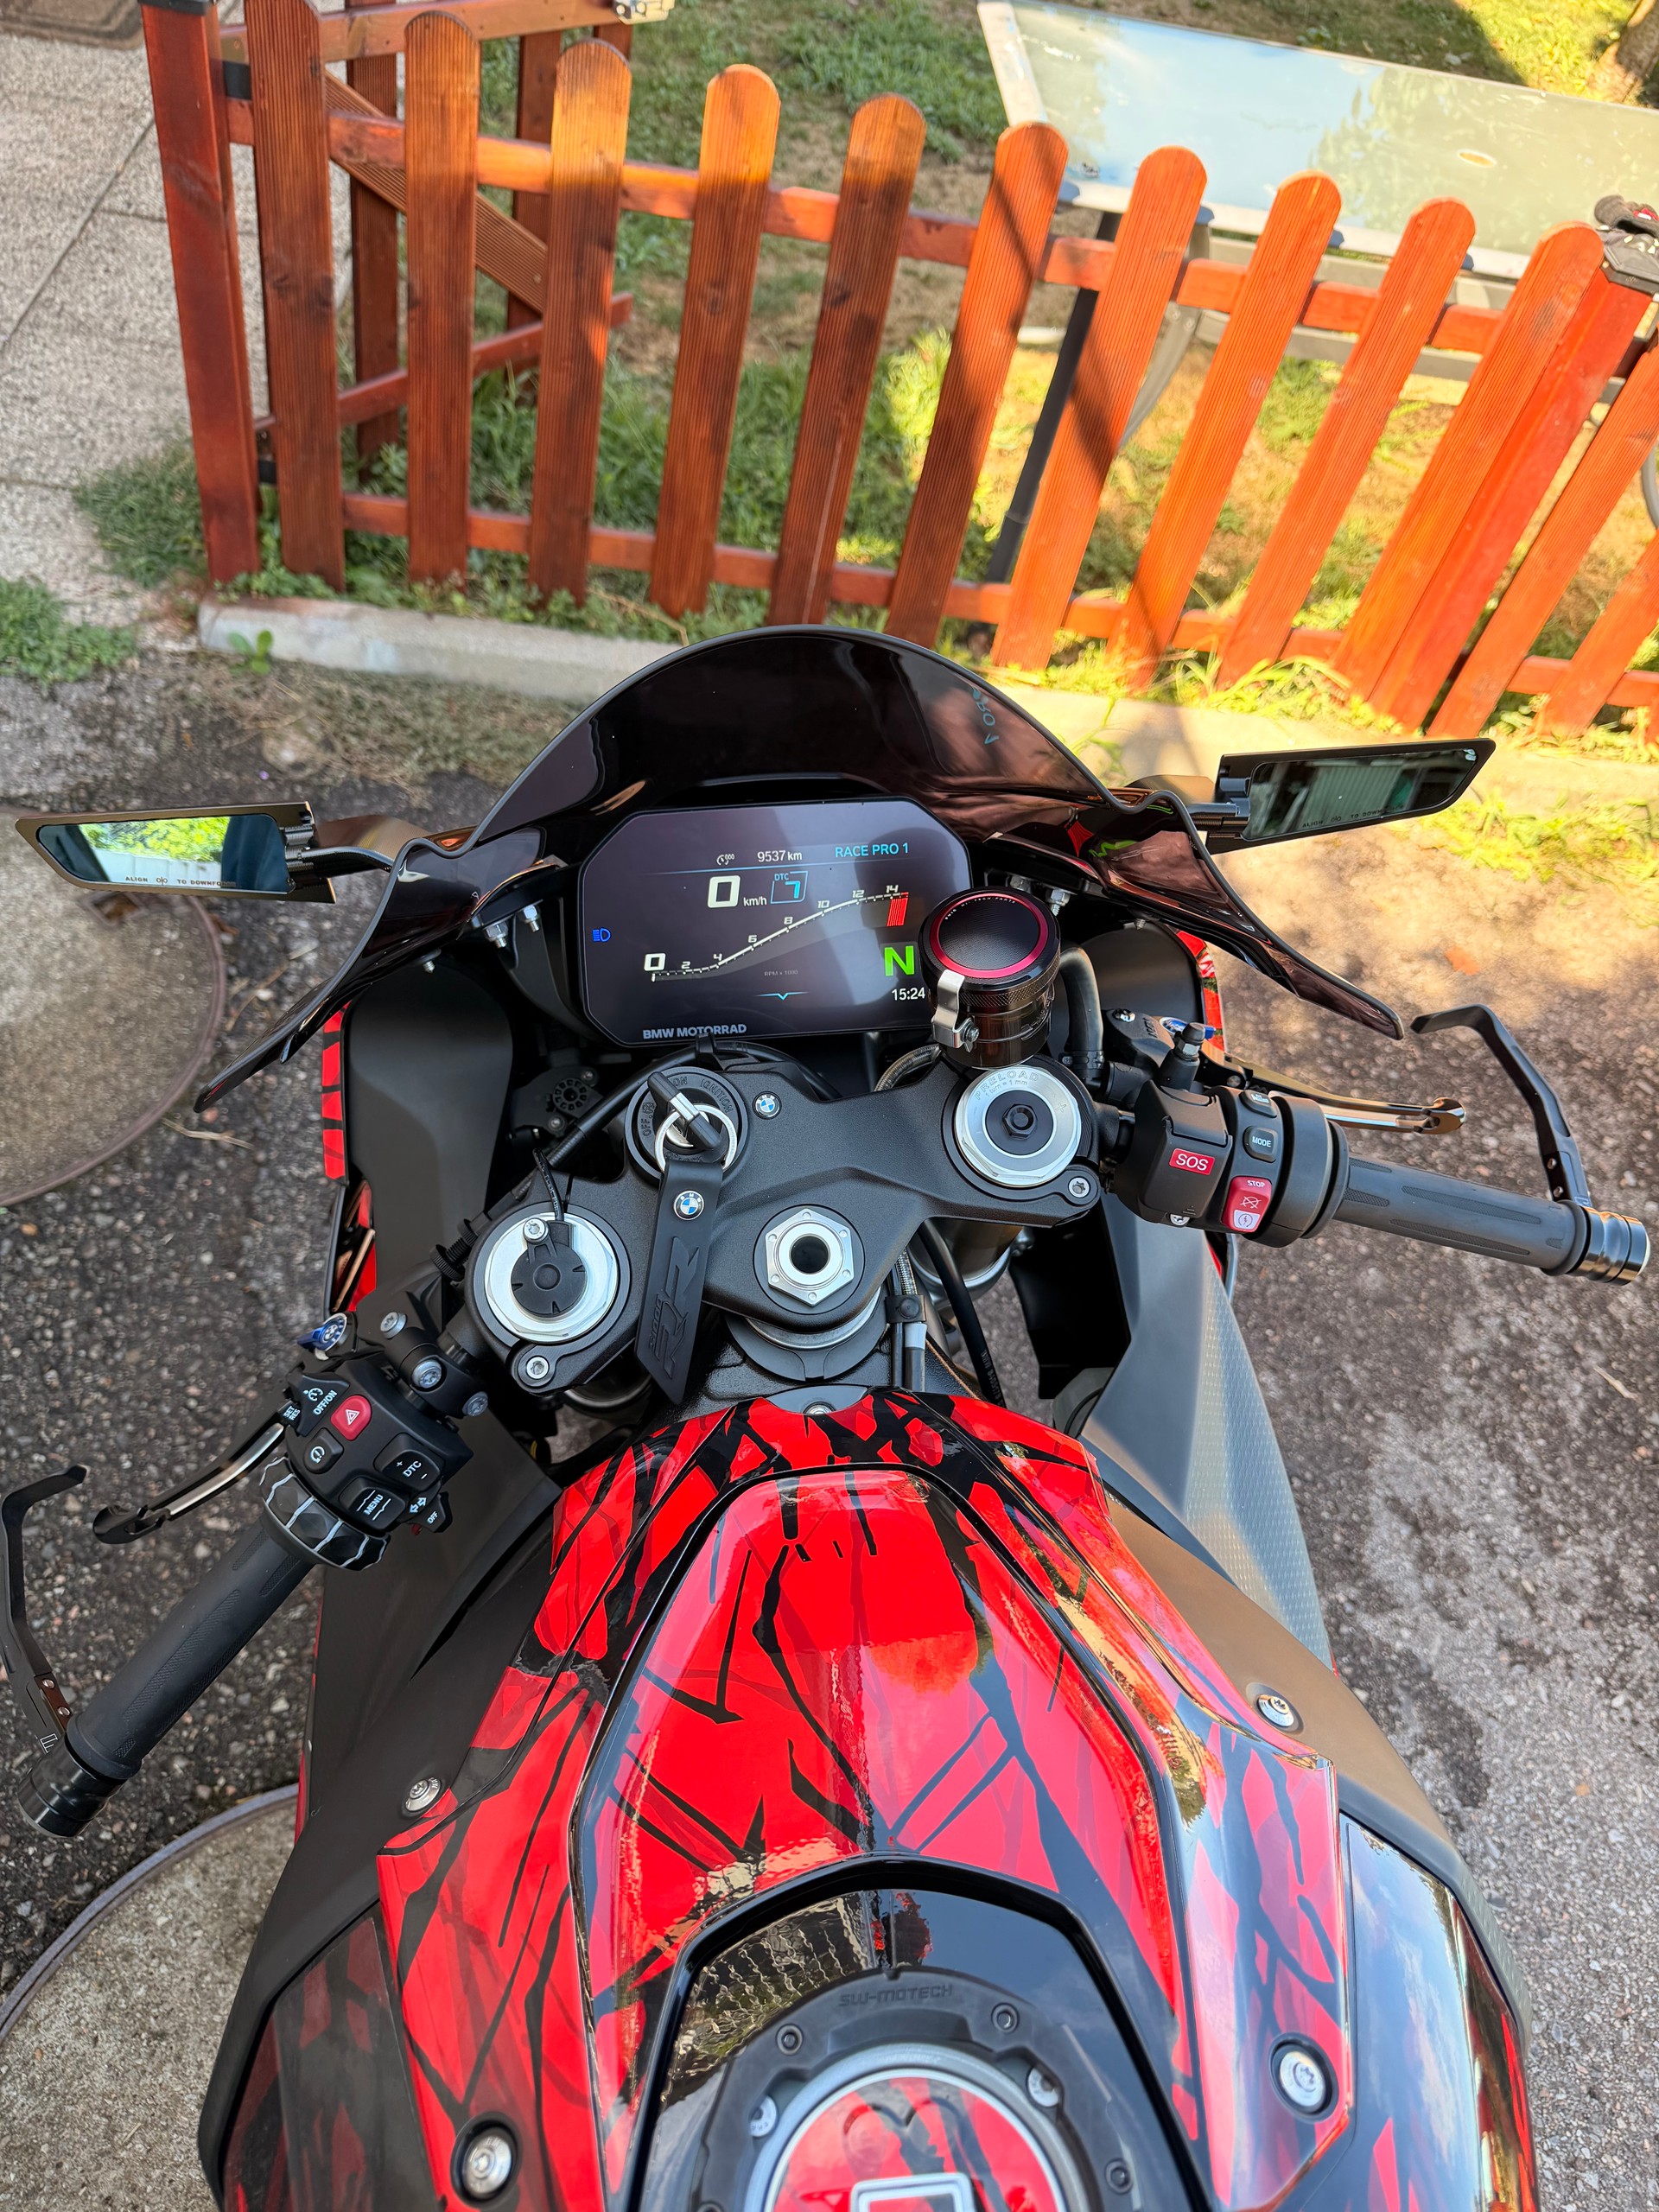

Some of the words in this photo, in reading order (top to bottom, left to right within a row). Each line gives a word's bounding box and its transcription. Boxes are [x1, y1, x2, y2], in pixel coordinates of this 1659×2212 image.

[757, 849, 786, 863] 9537
[787, 851, 802, 861] km
[835, 845, 869, 858] RACE
[872, 842, 899, 855] PRO
[902, 842, 909, 854] 1
[774, 873, 789, 881] DTC
[708, 874, 741, 908] 0
[743, 896, 767, 906] km/h
[785, 880, 801, 899] 7
[852, 889, 865, 898] 12
[886, 884, 899, 893] 14
[817, 899, 830, 909] 10
[784, 916, 794, 925] 8
[747, 934, 758, 944] 6
[644, 952, 666, 971] 0
[681, 961, 691, 969] 2
[884, 945, 915, 976] N
[892, 987, 925, 1001] 15:24
[643, 1028, 674, 1039] BMW
[677, 1024, 747, 1038] MOTORRAD
[974, 1070, 1039, 1101] PRELOAD
[700, 1078, 734, 1114] IGNITION
[643, 1118, 652, 1138] OFF
[1251, 1135, 1272, 1147] MODE
[1176, 1154, 1209, 1171] SOS
[1247, 1179, 1266, 1188] STOP
[313, 1389, 338, 1415] OFF/ON
[283, 1405, 295, 1418] SET
[288, 1408, 302, 1421] RES
[402, 1460, 422, 1478] DTC
[364, 1494, 384, 1516] MENU
[427, 1510, 438, 1524] OFF
